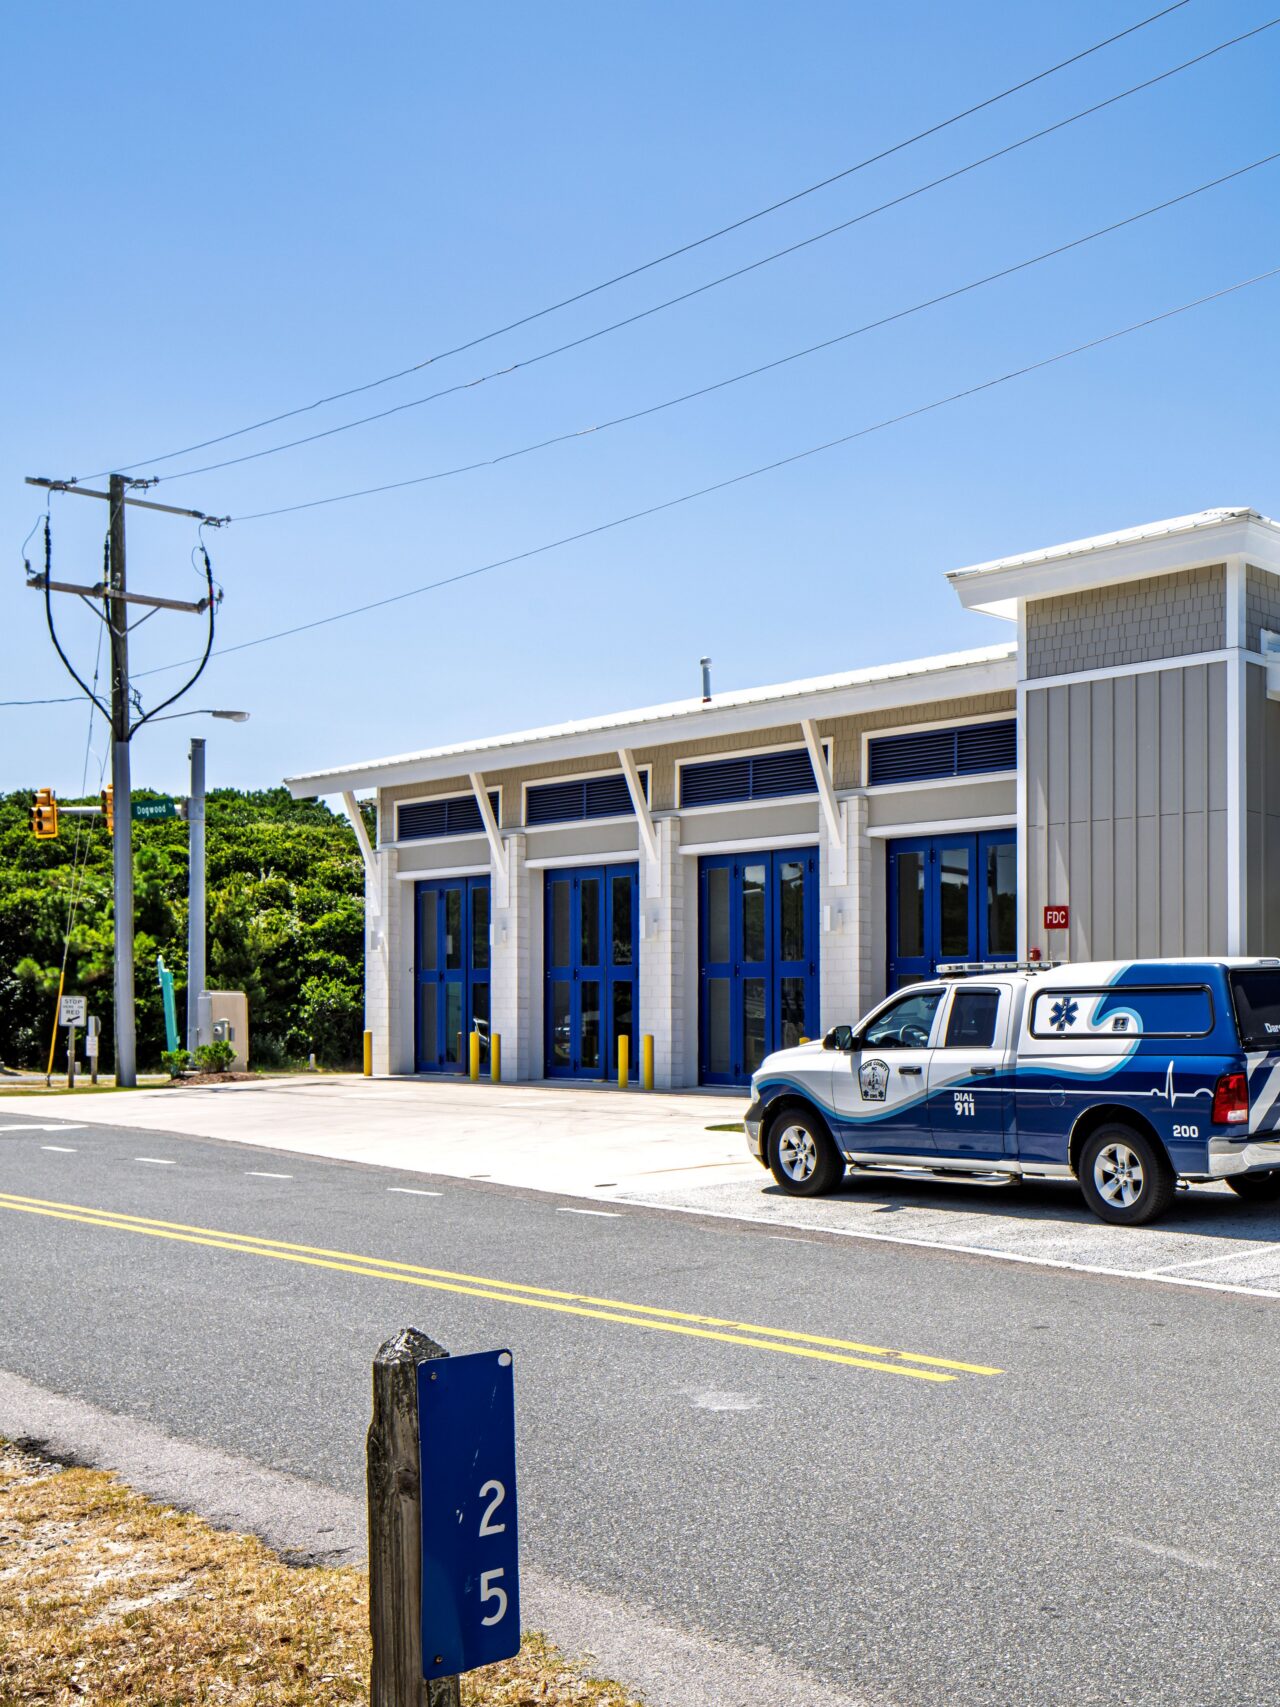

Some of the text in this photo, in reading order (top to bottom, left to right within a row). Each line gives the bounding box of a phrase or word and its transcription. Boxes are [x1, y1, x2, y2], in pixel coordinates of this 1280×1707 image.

[136, 804, 166, 817] Dogwood
[1046, 911, 1066, 924] FDC
[873, 1061, 888, 1071] COUNTY
[954, 1092, 975, 1102] DIAL
[954, 1102, 975, 1116] 911
[1172, 1125, 1198, 1138] 200
